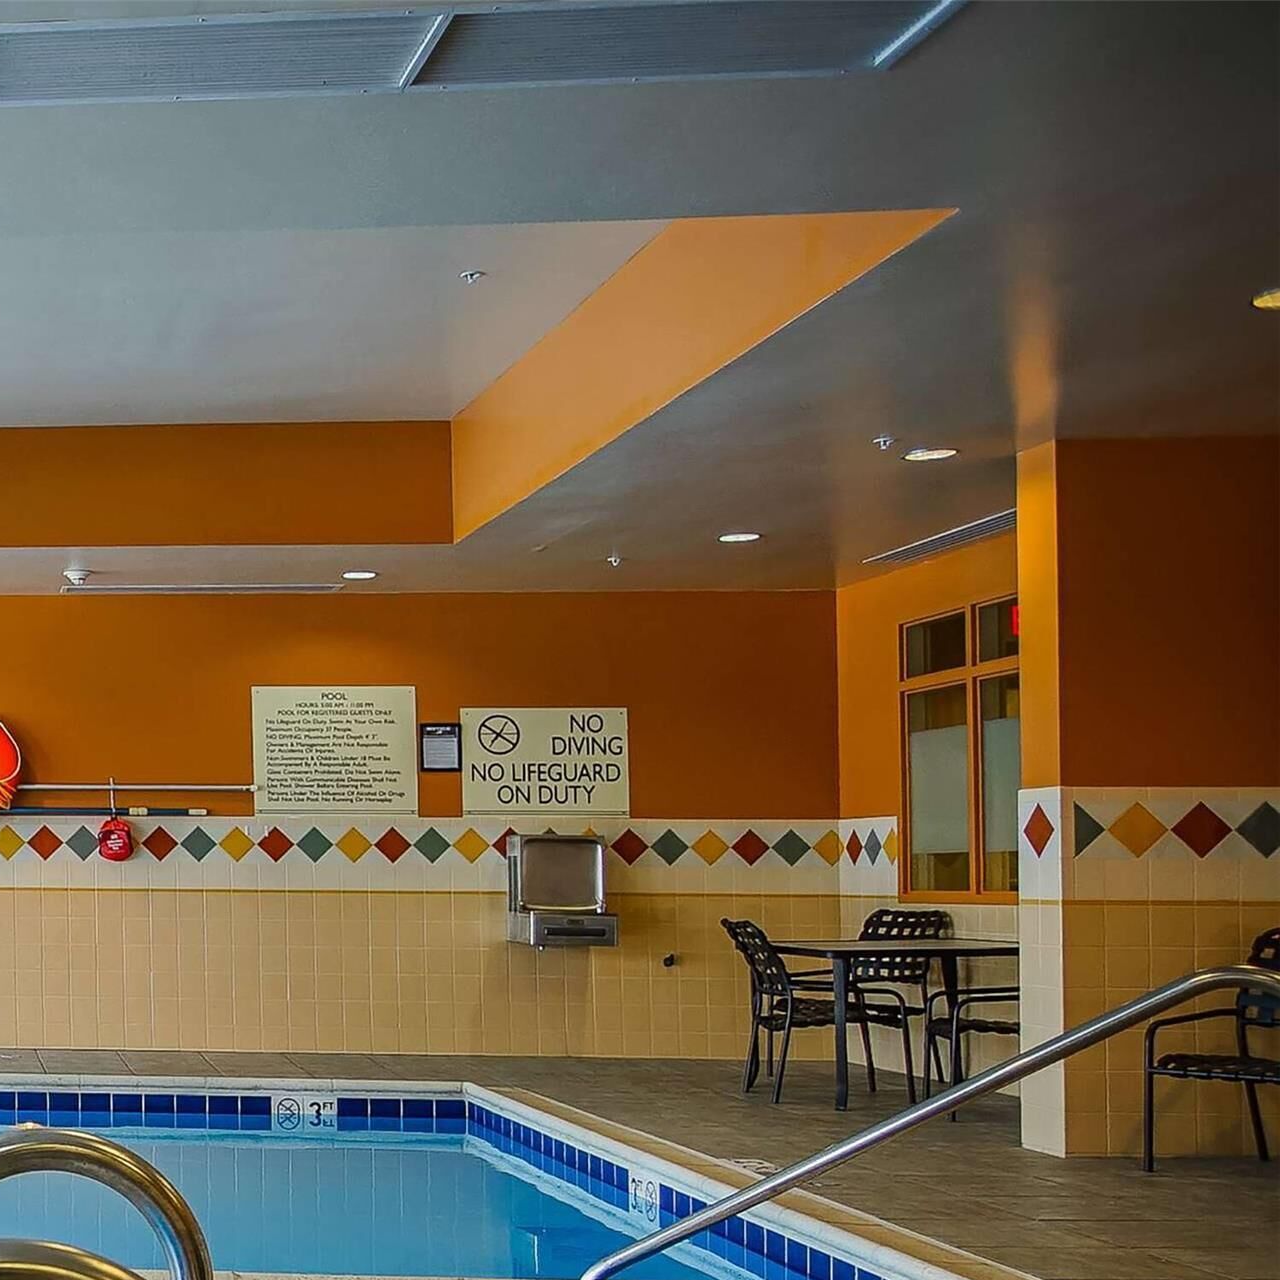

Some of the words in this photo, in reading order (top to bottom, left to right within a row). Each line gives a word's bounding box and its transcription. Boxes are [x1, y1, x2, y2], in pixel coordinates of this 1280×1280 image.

[321, 692, 348, 700] POOL
[569, 714, 604, 734] NO
[551, 736, 624, 756] DIVING
[471, 763, 505, 783] NO
[512, 763, 621, 783] LIFEGUARD
[497, 785, 531, 804] ON
[538, 785, 596, 805] DUTY
